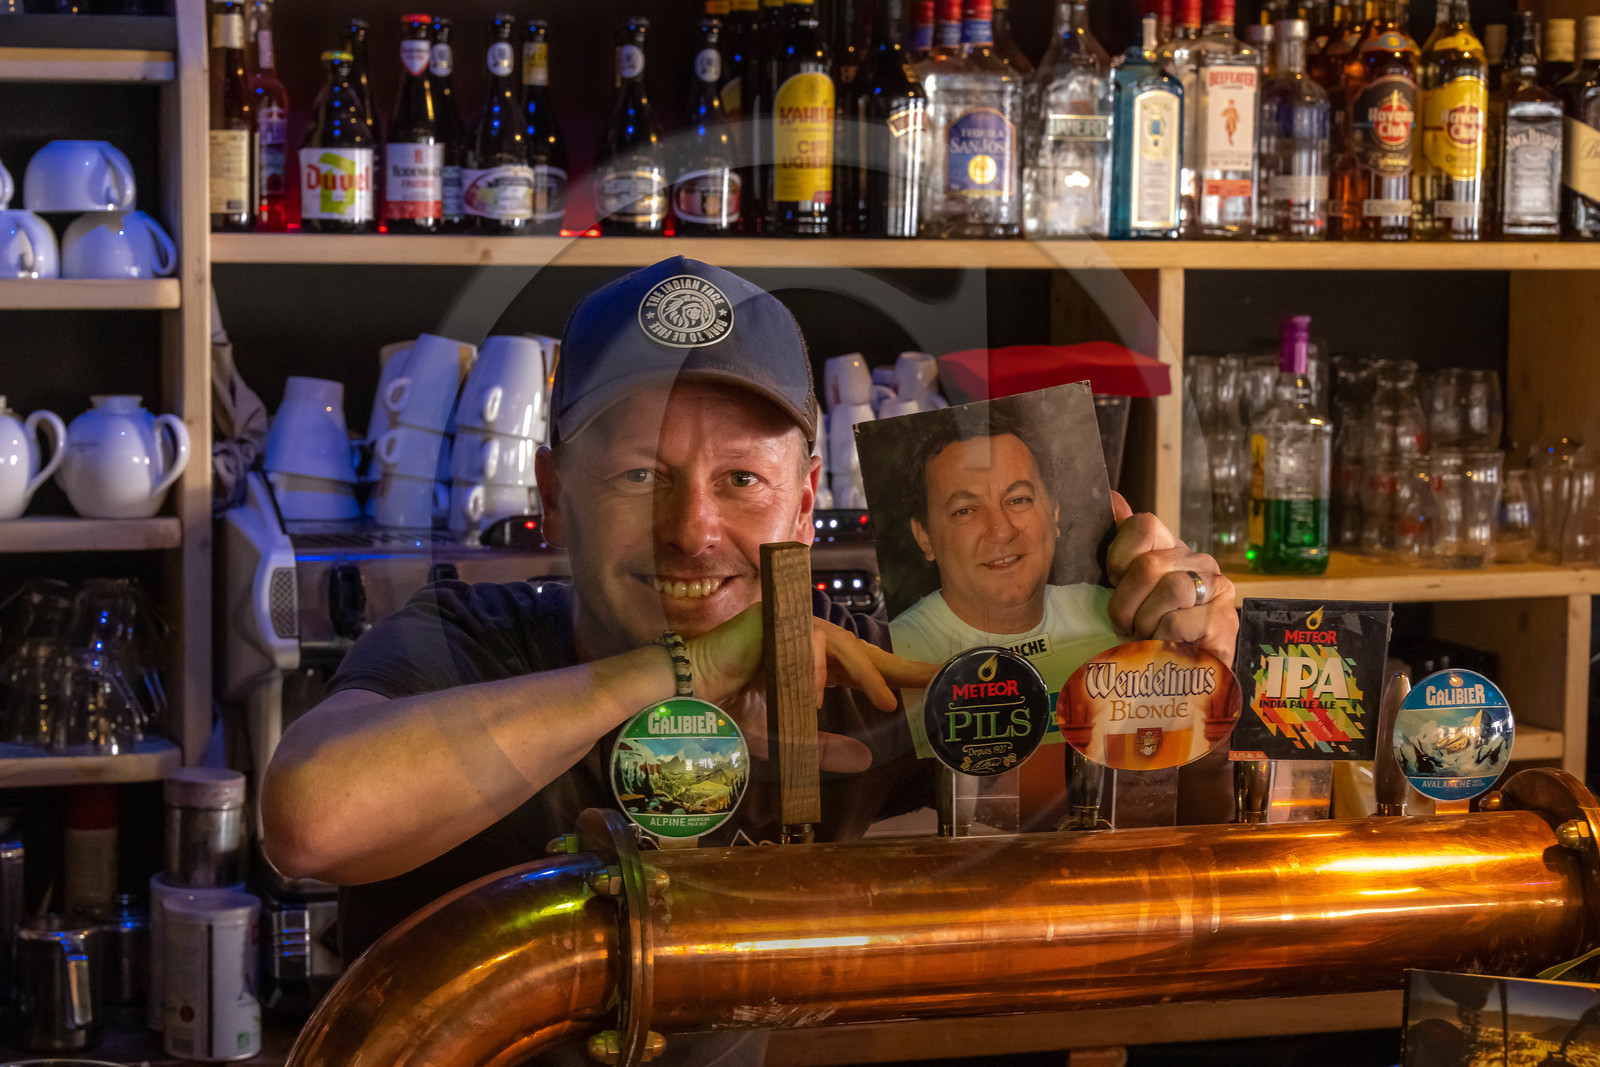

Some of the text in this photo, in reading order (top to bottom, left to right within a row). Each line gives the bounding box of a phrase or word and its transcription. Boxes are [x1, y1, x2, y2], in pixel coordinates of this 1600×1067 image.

[306, 163, 371, 192] Duvel
[646, 278, 725, 307] THE INDIAN FACE
[648, 318, 728, 343] BORN TO BE FREE
[1284, 629, 1337, 644] METEOR
[1086, 661, 1217, 699] Wendelinus
[1265, 656, 1350, 699] IPA
[952, 680, 1020, 701] METEOR
[1426, 684, 1486, 706] GALIBIER
[1259, 699, 1336, 710] INDIA PALE ALE
[648, 711, 718, 735] GALIBIER
[944, 707, 1032, 743] PILS
[968, 745, 1007, 758] Depuis 1927
[1422, 779, 1472, 788] AVALANCHE
[650, 817, 686, 827] ALPINE
